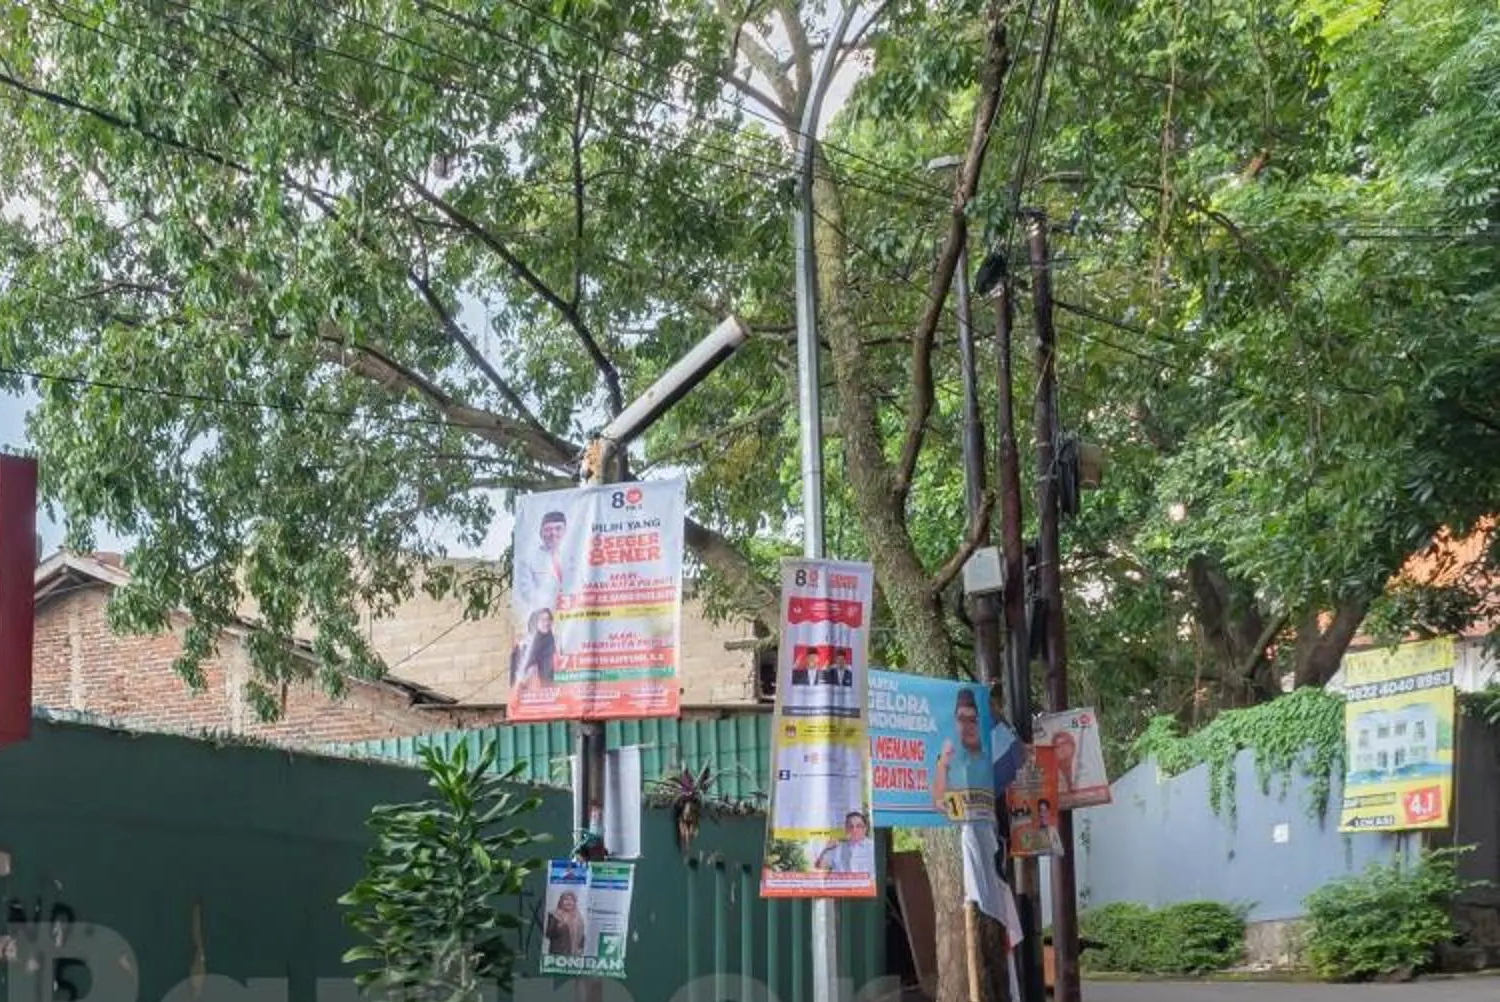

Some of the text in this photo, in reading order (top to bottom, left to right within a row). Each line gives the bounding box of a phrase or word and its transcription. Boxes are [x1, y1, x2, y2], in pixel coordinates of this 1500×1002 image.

[612, 491, 625, 509] 8
[628, 517, 661, 530] YANG
[795, 569, 807, 587] 8
[868, 710, 938, 733] NDONESIA
[876, 735, 925, 761] MENANG
